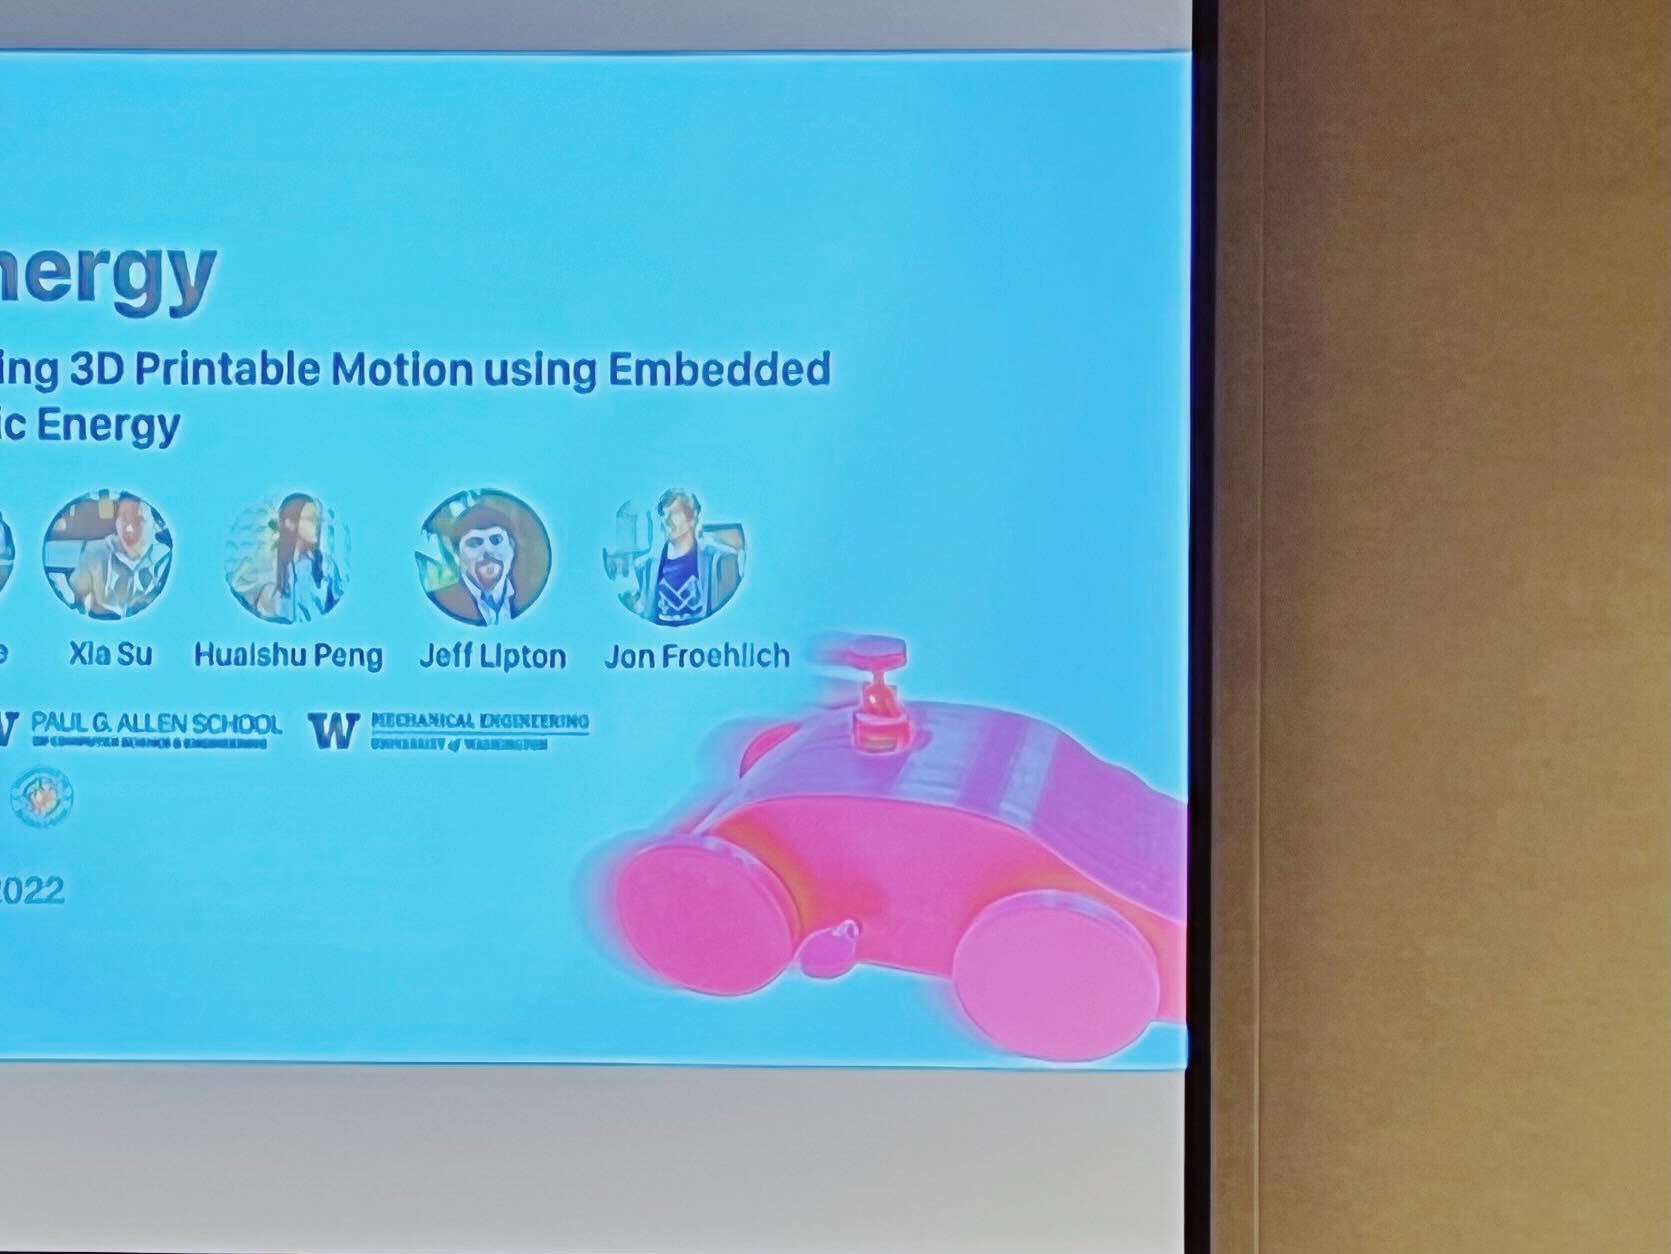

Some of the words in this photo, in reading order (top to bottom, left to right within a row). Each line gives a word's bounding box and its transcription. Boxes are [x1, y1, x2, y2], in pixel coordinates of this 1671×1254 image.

[70, 350, 125, 387] 3D
[135, 348, 321, 387] Printable
[332, 349, 474, 387] Motion
[484, 350, 597, 395] using
[609, 349, 832, 388] Embedded
[37, 406, 182, 450] Energy
[69, 640, 112, 666] Xia
[117, 640, 153, 667] Su
[194, 640, 307, 667] Huaishu
[314, 642, 383, 674] Peng
[419, 640, 473, 669] Jeff
[480, 642, 567, 674] Lipton
[604, 643, 656, 670] Jon
[662, 641, 791, 669] Froehlich
[31, 710, 89, 733] PAUL
[117, 712, 188, 734] ALLEN
[192, 712, 283, 735] SCHOOL
[307, 711, 361, 750] W
